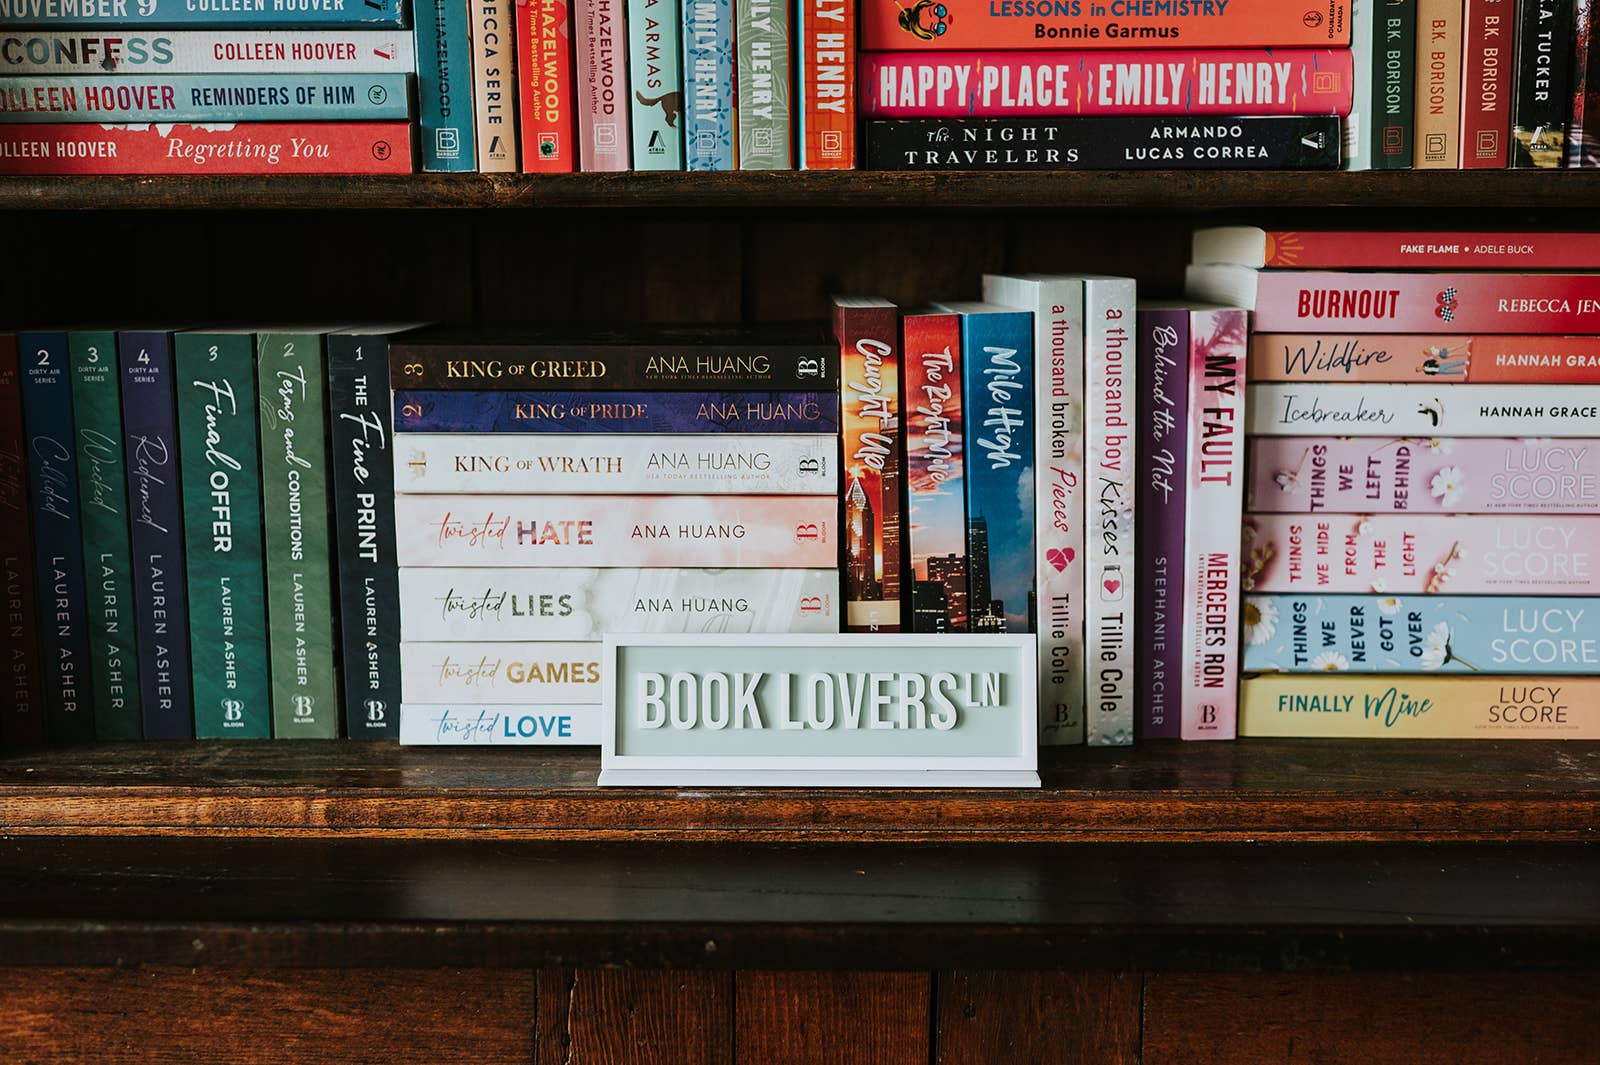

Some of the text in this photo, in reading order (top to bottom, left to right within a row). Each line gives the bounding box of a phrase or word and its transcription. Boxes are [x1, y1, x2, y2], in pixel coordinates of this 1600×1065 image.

[530, 10, 539, 37] Times
[586, 11, 595, 36] Times
[990, 0, 1229, 17] LESSONS CHEMISTRY
[1035, 23, 1180, 39] Bonnie Garmus
[1484, 16, 1500, 40] B.K.
[213, 43, 357, 60] COLLEEN HOOVER
[531, 38, 540, 87] Bestselling
[541, 0, 559, 122] HAZELWOOD
[588, 38, 597, 83] Bestselling
[598, 1, 615, 115] HAZELWOOD
[645, 18, 662, 88] ARMAS
[1386, 18, 1401, 114] B.K. BORISON
[1430, 19, 1447, 115] B.K. BORISON
[1535, 31, 1552, 101] TUCKER
[751, 42, 773, 120] HENRY
[816, 33, 846, 113] HENRY
[880, 65, 1070, 107] HAPPY PLACE
[1098, 62, 1292, 106] EMILY HENRY
[1481, 47, 1499, 112] BORISON
[85, 85, 176, 112] HOOVER
[191, 86, 355, 106] REMINDERS OF HIM
[485, 68, 502, 124] SERLE
[533, 89, 541, 121] Author
[695, 59, 718, 123] HENRY
[56, 141, 117, 158] HOOVER
[963, 127, 1058, 141] NIGHT
[1150, 126, 1243, 139] ARMANDO
[166, 138, 329, 165] Regretting You
[905, 149, 1080, 164] TRAVELERS
[1125, 146, 1269, 160] LUCAS CORREA
[1400, 244, 1460, 254] FAKE FLAME
[1474, 245, 1534, 254] ADELE BUCK
[1298, 289, 1400, 319] BURNOUT
[1498, 299, 1571, 313] REBECCA
[37, 350, 50, 366] 2
[87, 347, 99, 363] 3
[137, 349, 150, 364] 4
[446, 360, 606, 378] KING GREED
[645, 355, 770, 374] ANA HUANG
[1153, 325, 1178, 407] Behind
[1284, 340, 1392, 375] Wildfire
[1496, 354, 1561, 367] HANNAH
[515, 403, 649, 420] KING PRIDE
[696, 402, 821, 421] ANA HUANG
[849, 338, 893, 470] Caught Up
[977, 346, 1024, 470] Mile High
[1050, 305, 1077, 532] a thousand broken Pieces
[1279, 394, 1394, 424] Icebreaker
[1479, 406, 1597, 418] HANNAH GRACE
[1201, 356, 1237, 487] MY FAULT
[1098, 328, 1128, 556] thousand boy Kisses
[193, 379, 242, 552] Final OFFER
[276, 365, 311, 561] Terms and CONDITIONS
[340, 375, 385, 563] THE Fine PRINT
[454, 456, 623, 473] KING WRATH
[647, 453, 771, 470] ANA HUANG
[1504, 448, 1586, 472] LUCY
[1310, 444, 1327, 513] THINGS
[1338, 464, 1354, 491] WE
[1366, 456, 1382, 500] LEFT
[1394, 446, 1411, 510] BEHIND
[1490, 474, 1597, 500] SCORE
[516, 520, 593, 545] HATE
[631, 524, 746, 539] ANA HUANG
[1317, 522, 1330, 555] HIDE
[1289, 525, 1303, 583] THINGS
[1345, 534, 1357, 576] FROM
[1374, 540, 1387, 570] THE
[1403, 531, 1416, 576] LIGHT
[511, 594, 573, 617] LIES
[634, 598, 749, 613] ANA HUANG
[1203, 553, 1228, 688] MERCEDES RON
[1503, 608, 1585, 633] LUCY
[52, 556, 76, 712] LAUREN ASHER
[101, 554, 124, 708] LAUREN ASHER
[150, 555, 172, 709] LAUREN ASHER
[221, 577, 237, 689] LAUREN ASHER
[293, 573, 307, 686] LAUREN ASHER
[365, 577, 379, 689] LAUREN ASHER
[1052, 593, 1069, 684] Tillie Cole
[1152, 557, 1167, 725] STEPHANIE ARCHER
[1293, 601, 1308, 666] THINGS
[1321, 620, 1336, 647] WE
[1350, 605, 1366, 663] NEVER
[1379, 616, 1394, 652] GOT
[1408, 611, 1424, 658] OVER
[1100, 612, 1123, 712] Tillie Cole
[1491, 638, 1598, 663] SCORE
[506, 662, 600, 684] GAMES
[638, 672, 1004, 731] BOOK LOVERS LN
[1278, 687, 1433, 728] FINALLY Mine
[1499, 686, 1561, 704] LUCY
[504, 715, 572, 738] LOVE
[1488, 705, 1568, 723] SCORE
